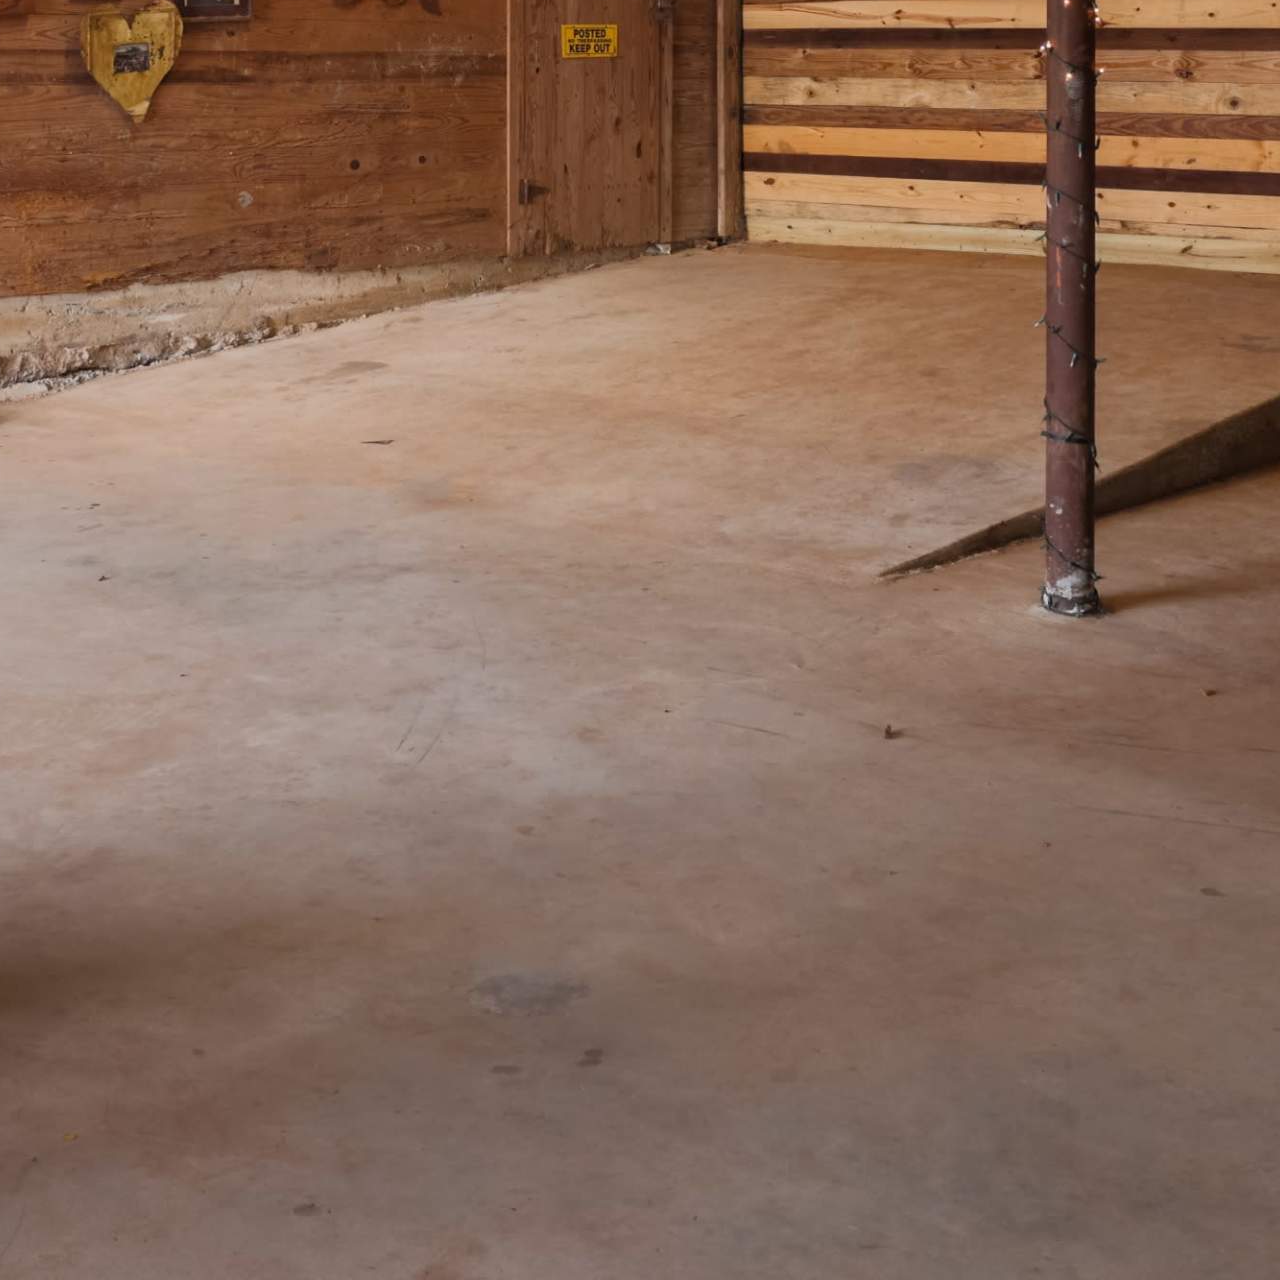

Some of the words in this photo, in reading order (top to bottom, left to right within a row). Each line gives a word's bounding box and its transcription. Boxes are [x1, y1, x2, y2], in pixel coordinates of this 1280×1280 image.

[574, 29, 606, 38] POSTED
[569, 44, 591, 53] KEEP
[594, 44, 610, 53] OUT
